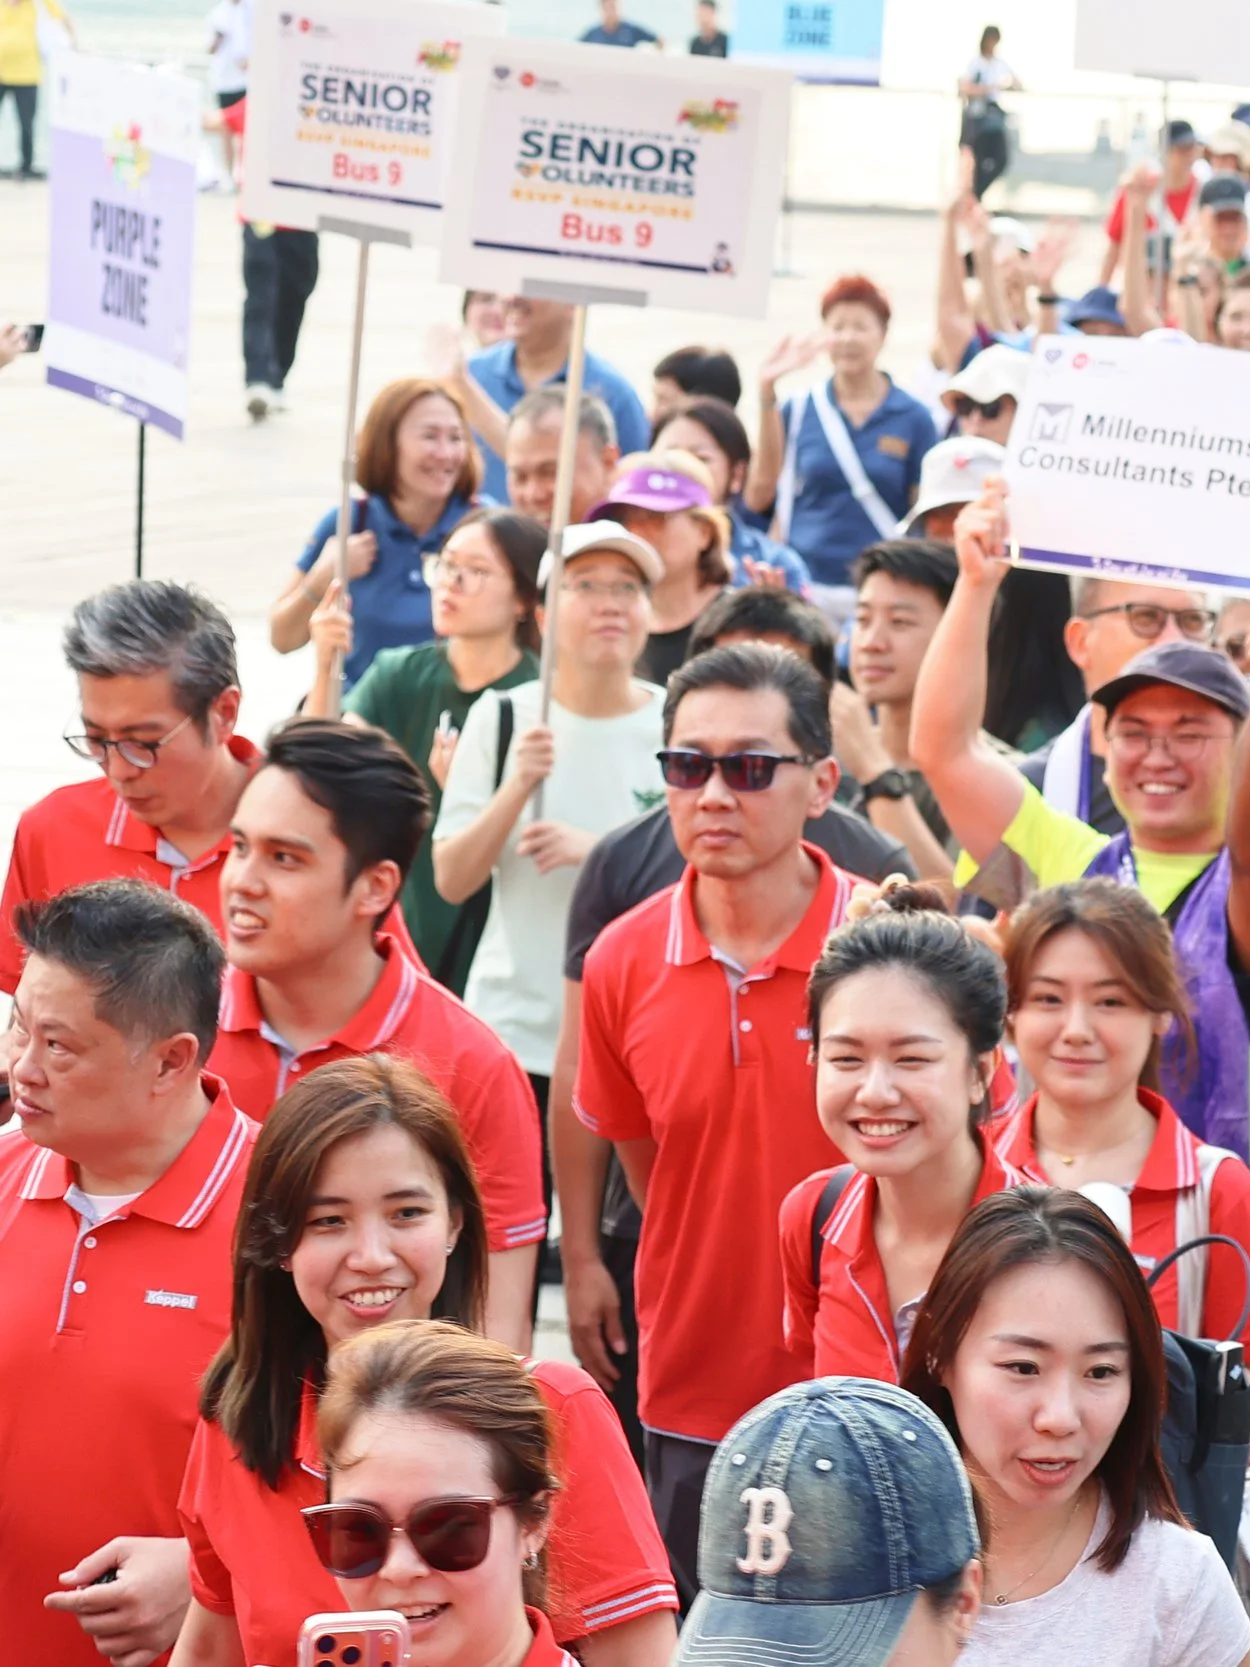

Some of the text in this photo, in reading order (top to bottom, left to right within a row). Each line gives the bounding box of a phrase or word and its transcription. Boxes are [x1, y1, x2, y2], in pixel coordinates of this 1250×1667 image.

[302, 74, 432, 116] SENIOR
[333, 153, 402, 186] Bus 9
[519, 130, 697, 177] SENIOR
[91, 197, 162, 269] PURPLE
[560, 212, 654, 249] Bus 9
[101, 263, 148, 327] ZONE
[1018, 446, 1194, 490] Consultants
[146, 1289, 195, 1308] Keppel
[736, 1487, 795, 1574] B
